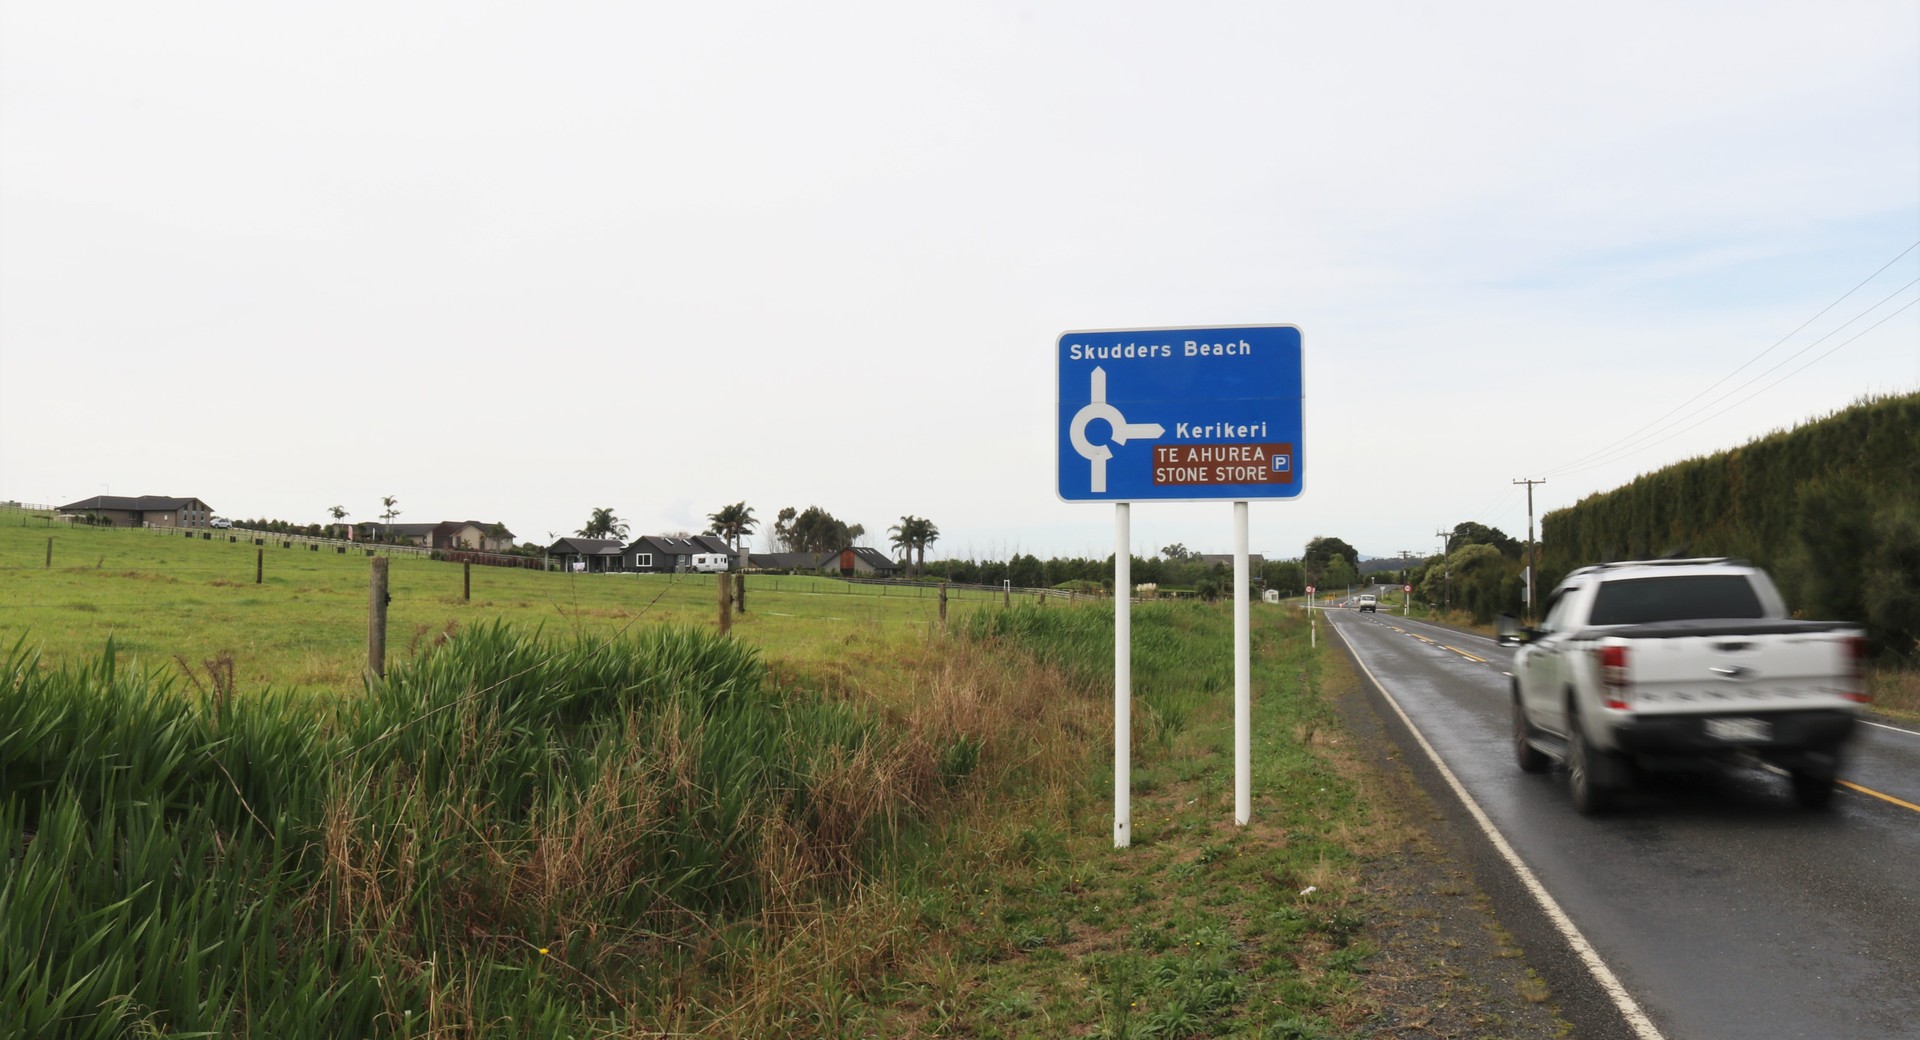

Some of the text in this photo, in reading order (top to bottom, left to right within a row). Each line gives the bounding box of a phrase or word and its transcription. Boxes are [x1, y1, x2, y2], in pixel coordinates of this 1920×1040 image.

[1070, 340, 1251, 360] Skudders Beach
[1176, 421, 1267, 439] Kerikeri
[1158, 446, 1265, 463] TE AHUREA
[1275, 457, 1287, 470] P
[1156, 466, 1268, 482] STONE STORE
